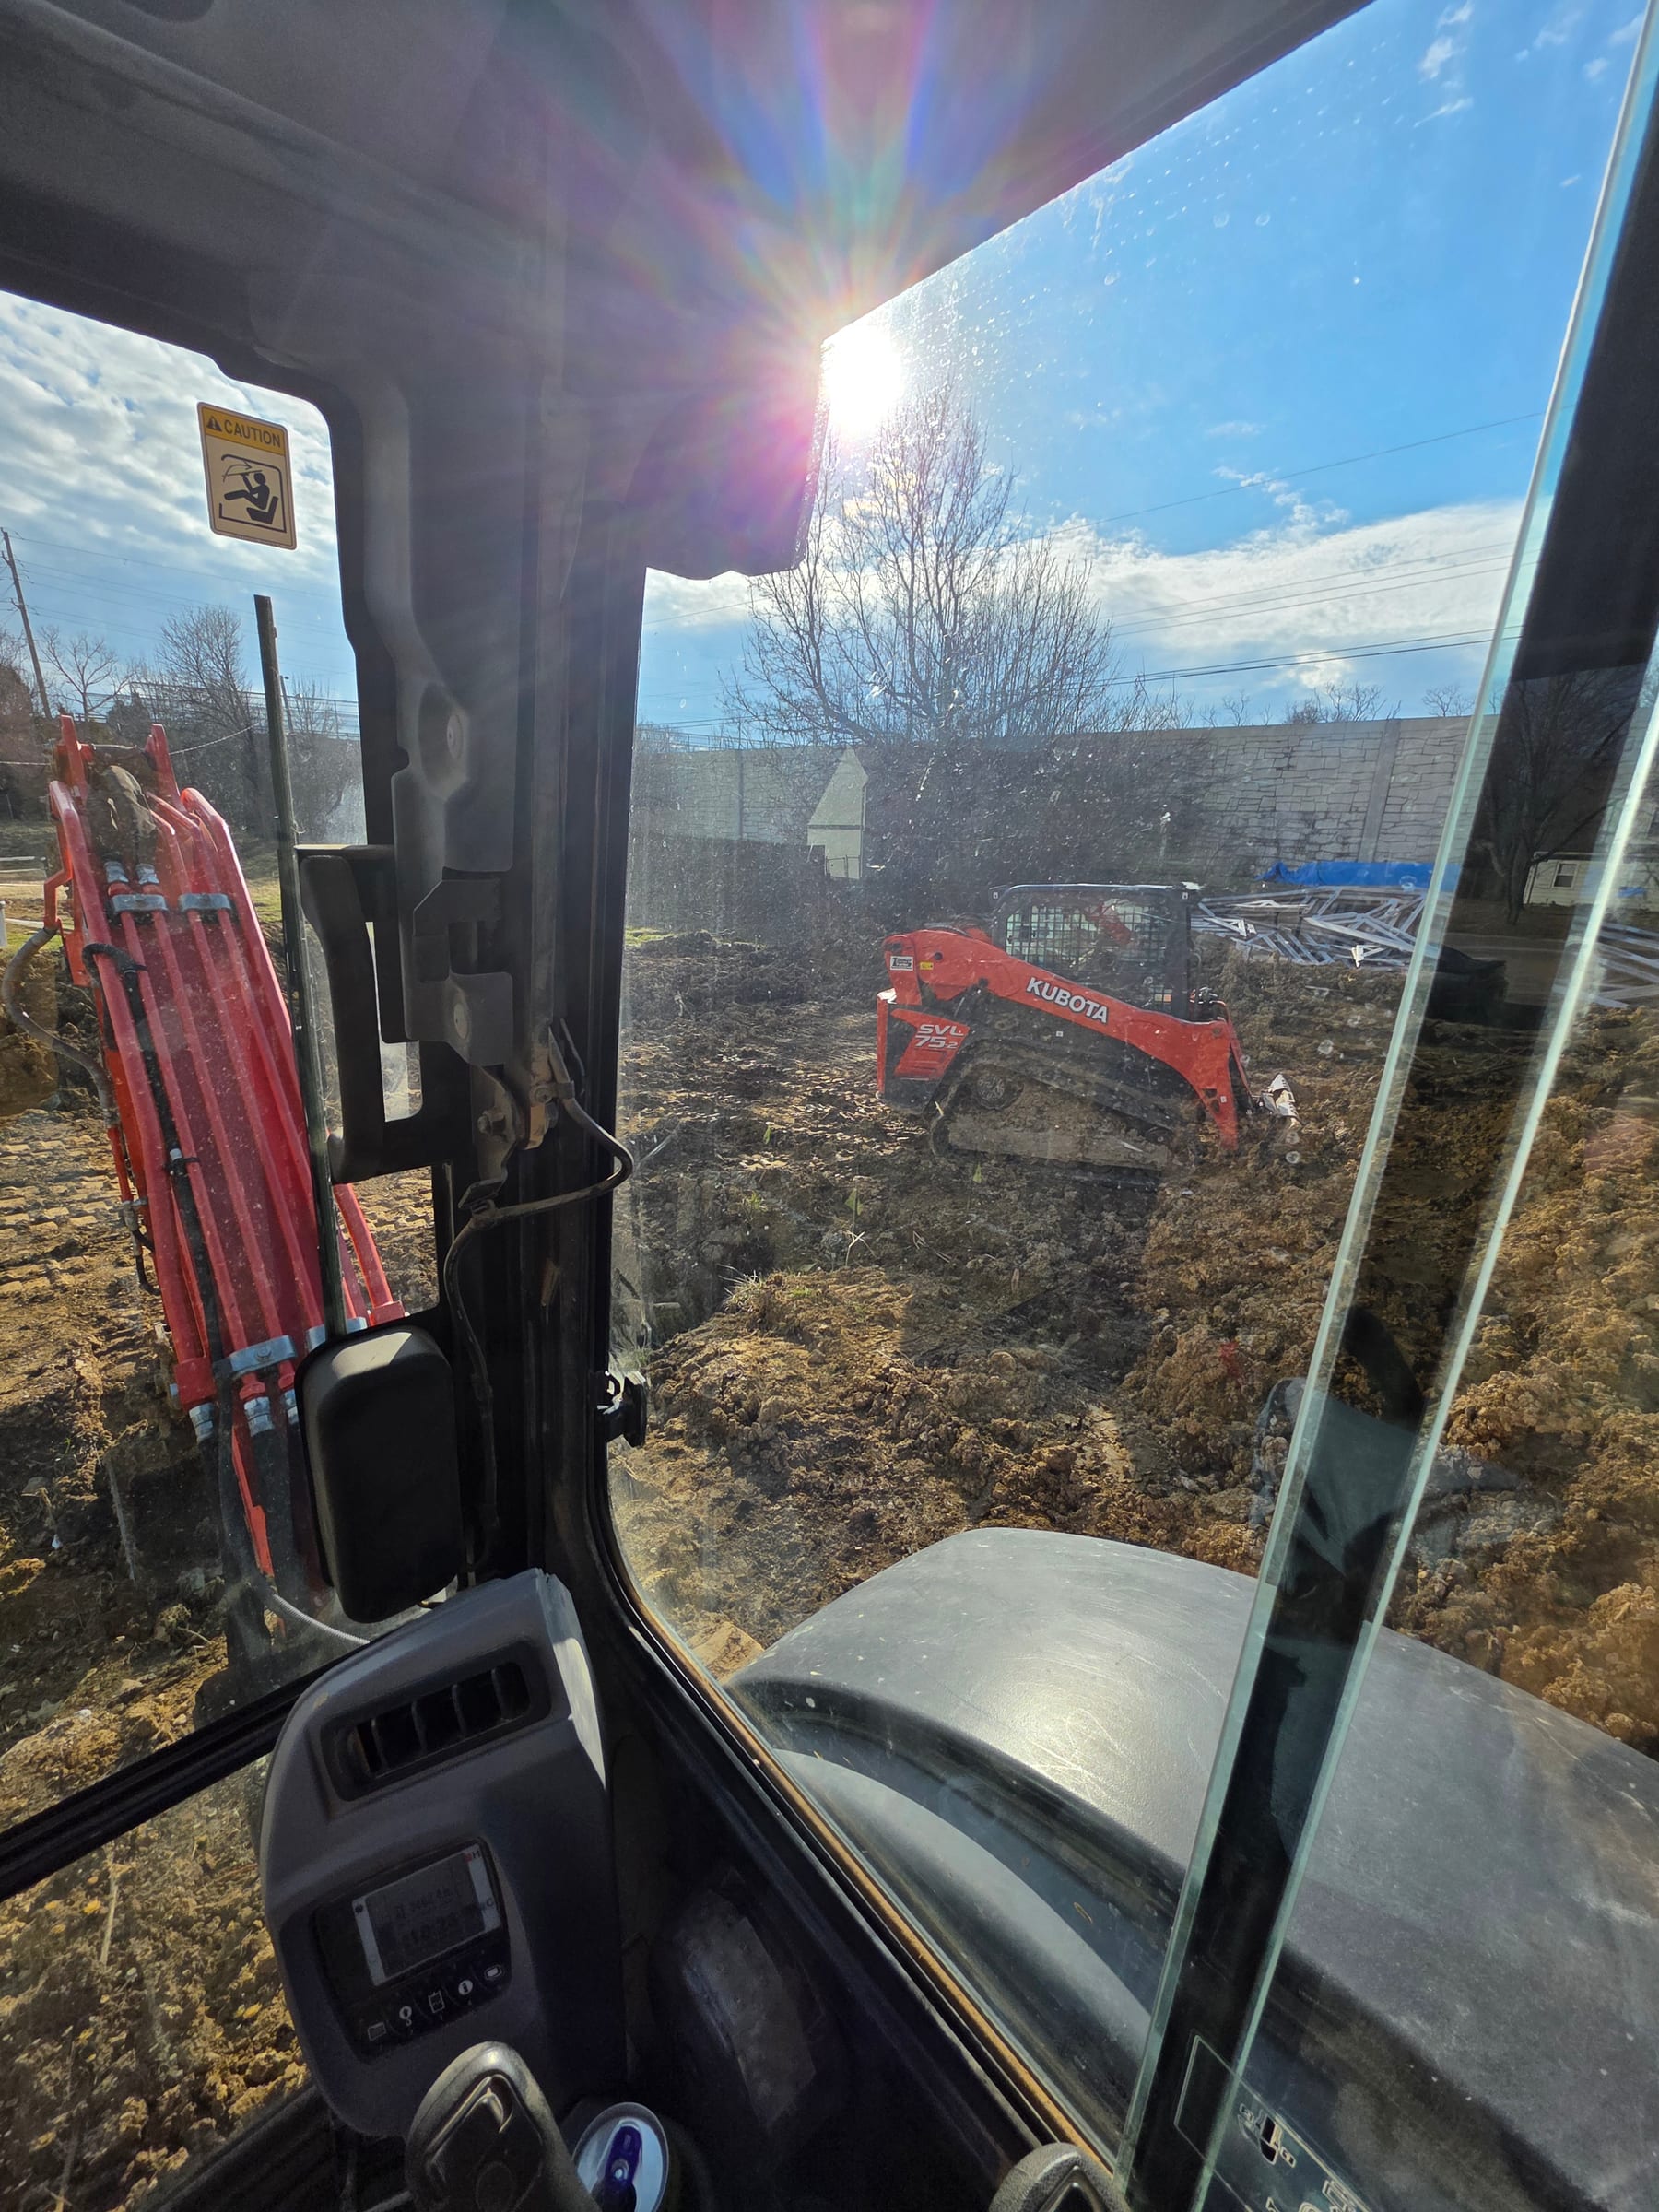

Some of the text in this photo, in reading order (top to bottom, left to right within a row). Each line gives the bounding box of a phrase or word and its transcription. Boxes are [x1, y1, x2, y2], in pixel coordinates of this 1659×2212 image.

[224, 419, 281, 448] CAUTION
[1026, 977, 1108, 1024] KUBOTA
[917, 1023, 964, 1036] SVL
